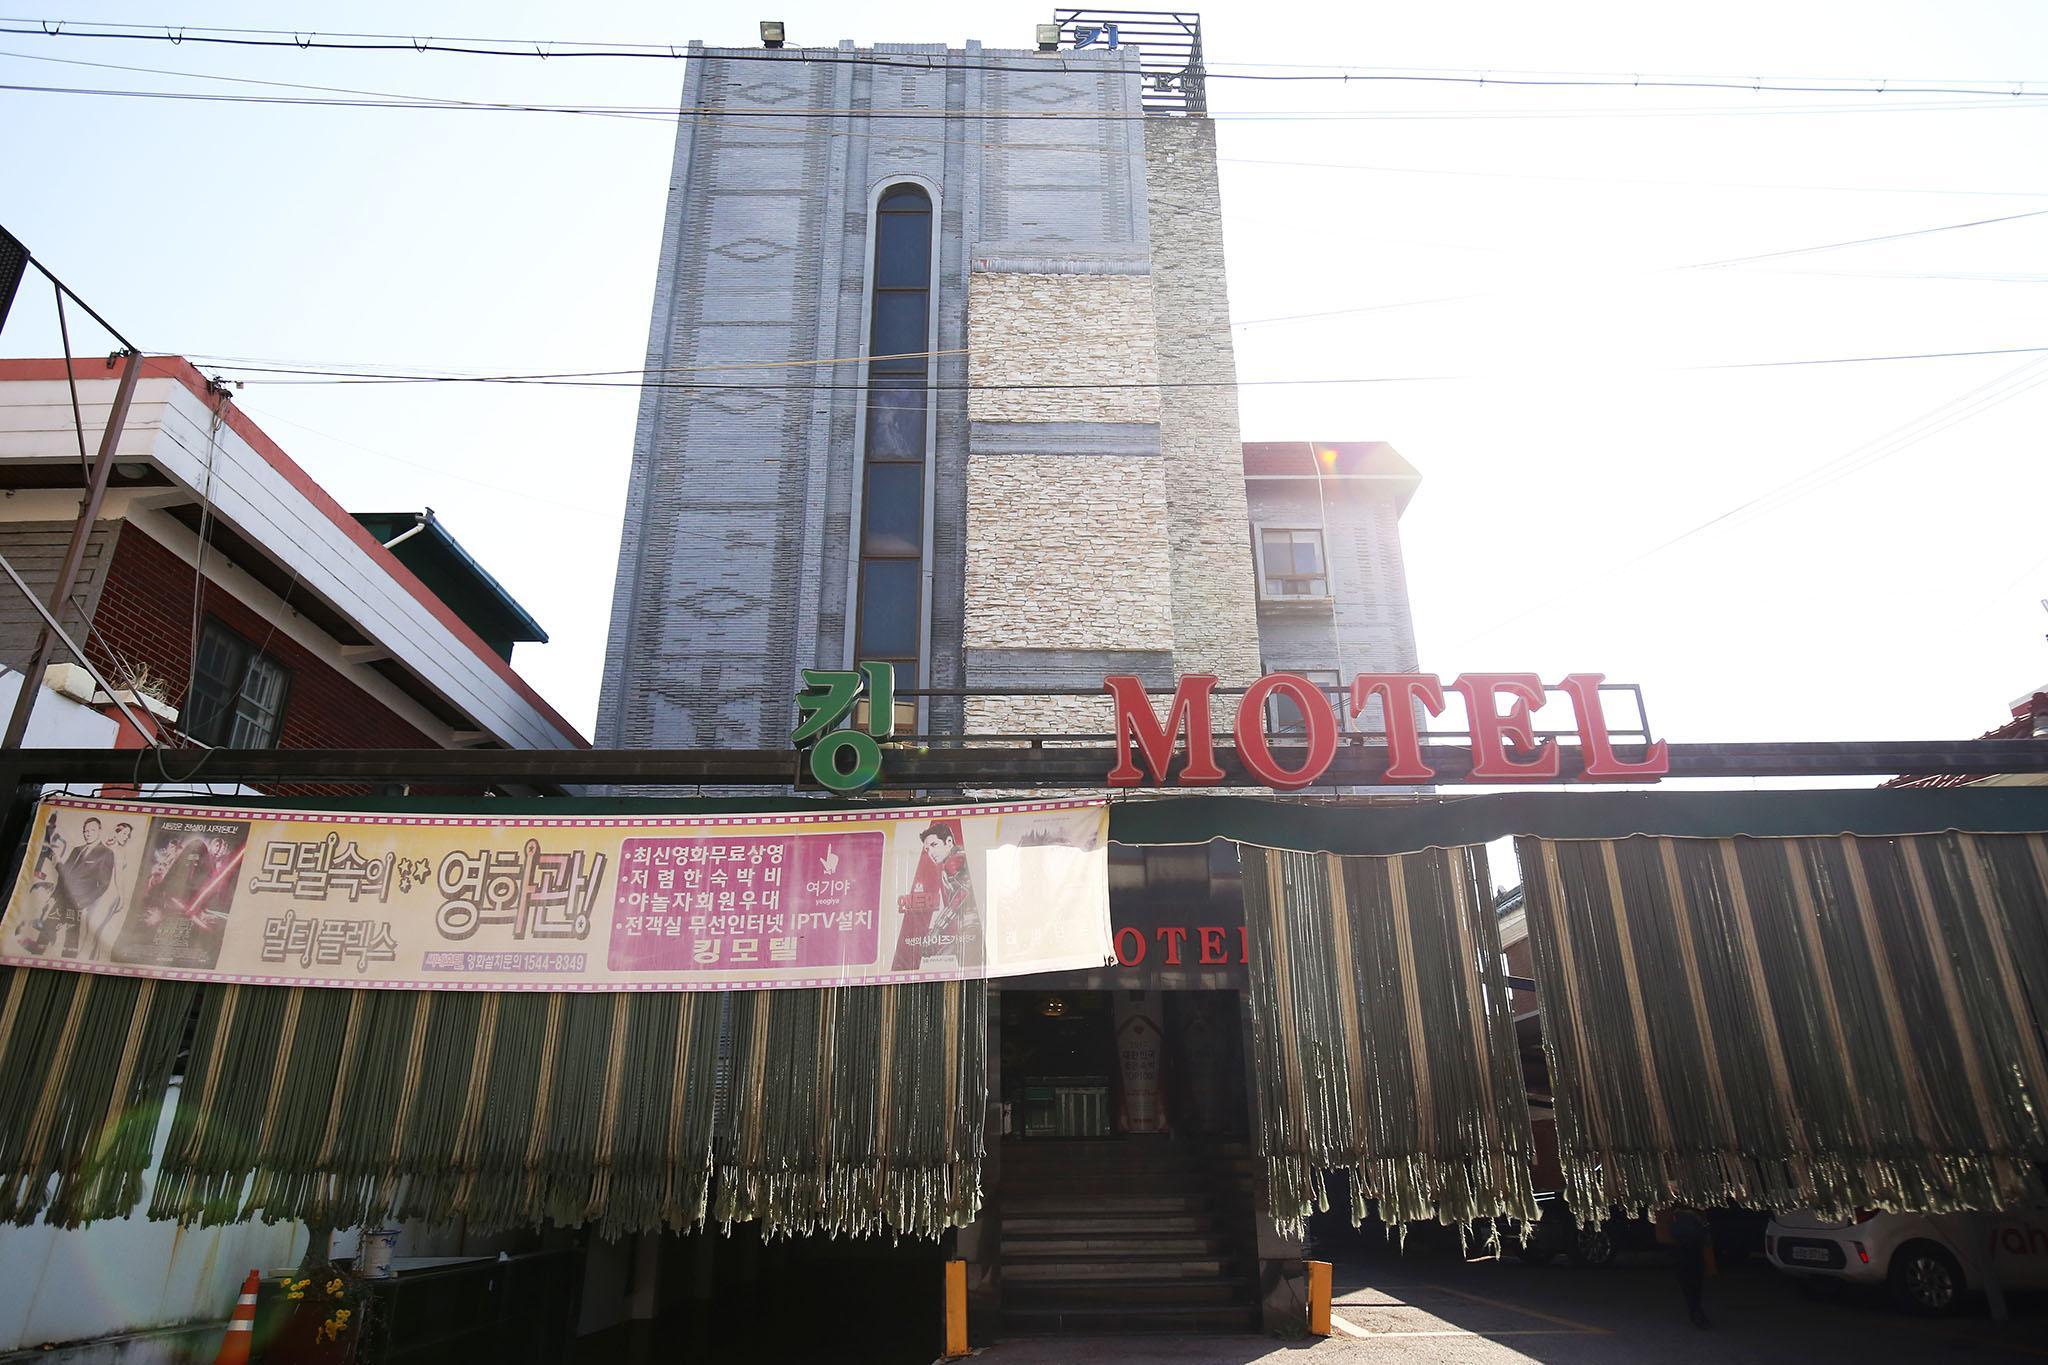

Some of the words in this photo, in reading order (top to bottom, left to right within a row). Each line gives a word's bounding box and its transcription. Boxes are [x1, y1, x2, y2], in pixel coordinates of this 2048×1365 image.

[790, 660, 895, 793] 킹
[1104, 673, 1670, 790] MOTEL
[250, 832, 397, 902] 모텔속의
[633, 844, 784, 866] 최신영화무료상영
[436, 838, 607, 940] 영화관!
[806, 879, 851, 897] 여기야
[815, 897, 840, 906] yeogiya
[624, 915, 682, 936] 전객실
[688, 912, 784, 935] 무선인터넷
[790, 909, 873, 931] IPTV설치
[262, 909, 400, 973] 멀티플렉스
[523, 953, 584, 971] 1544-8349
